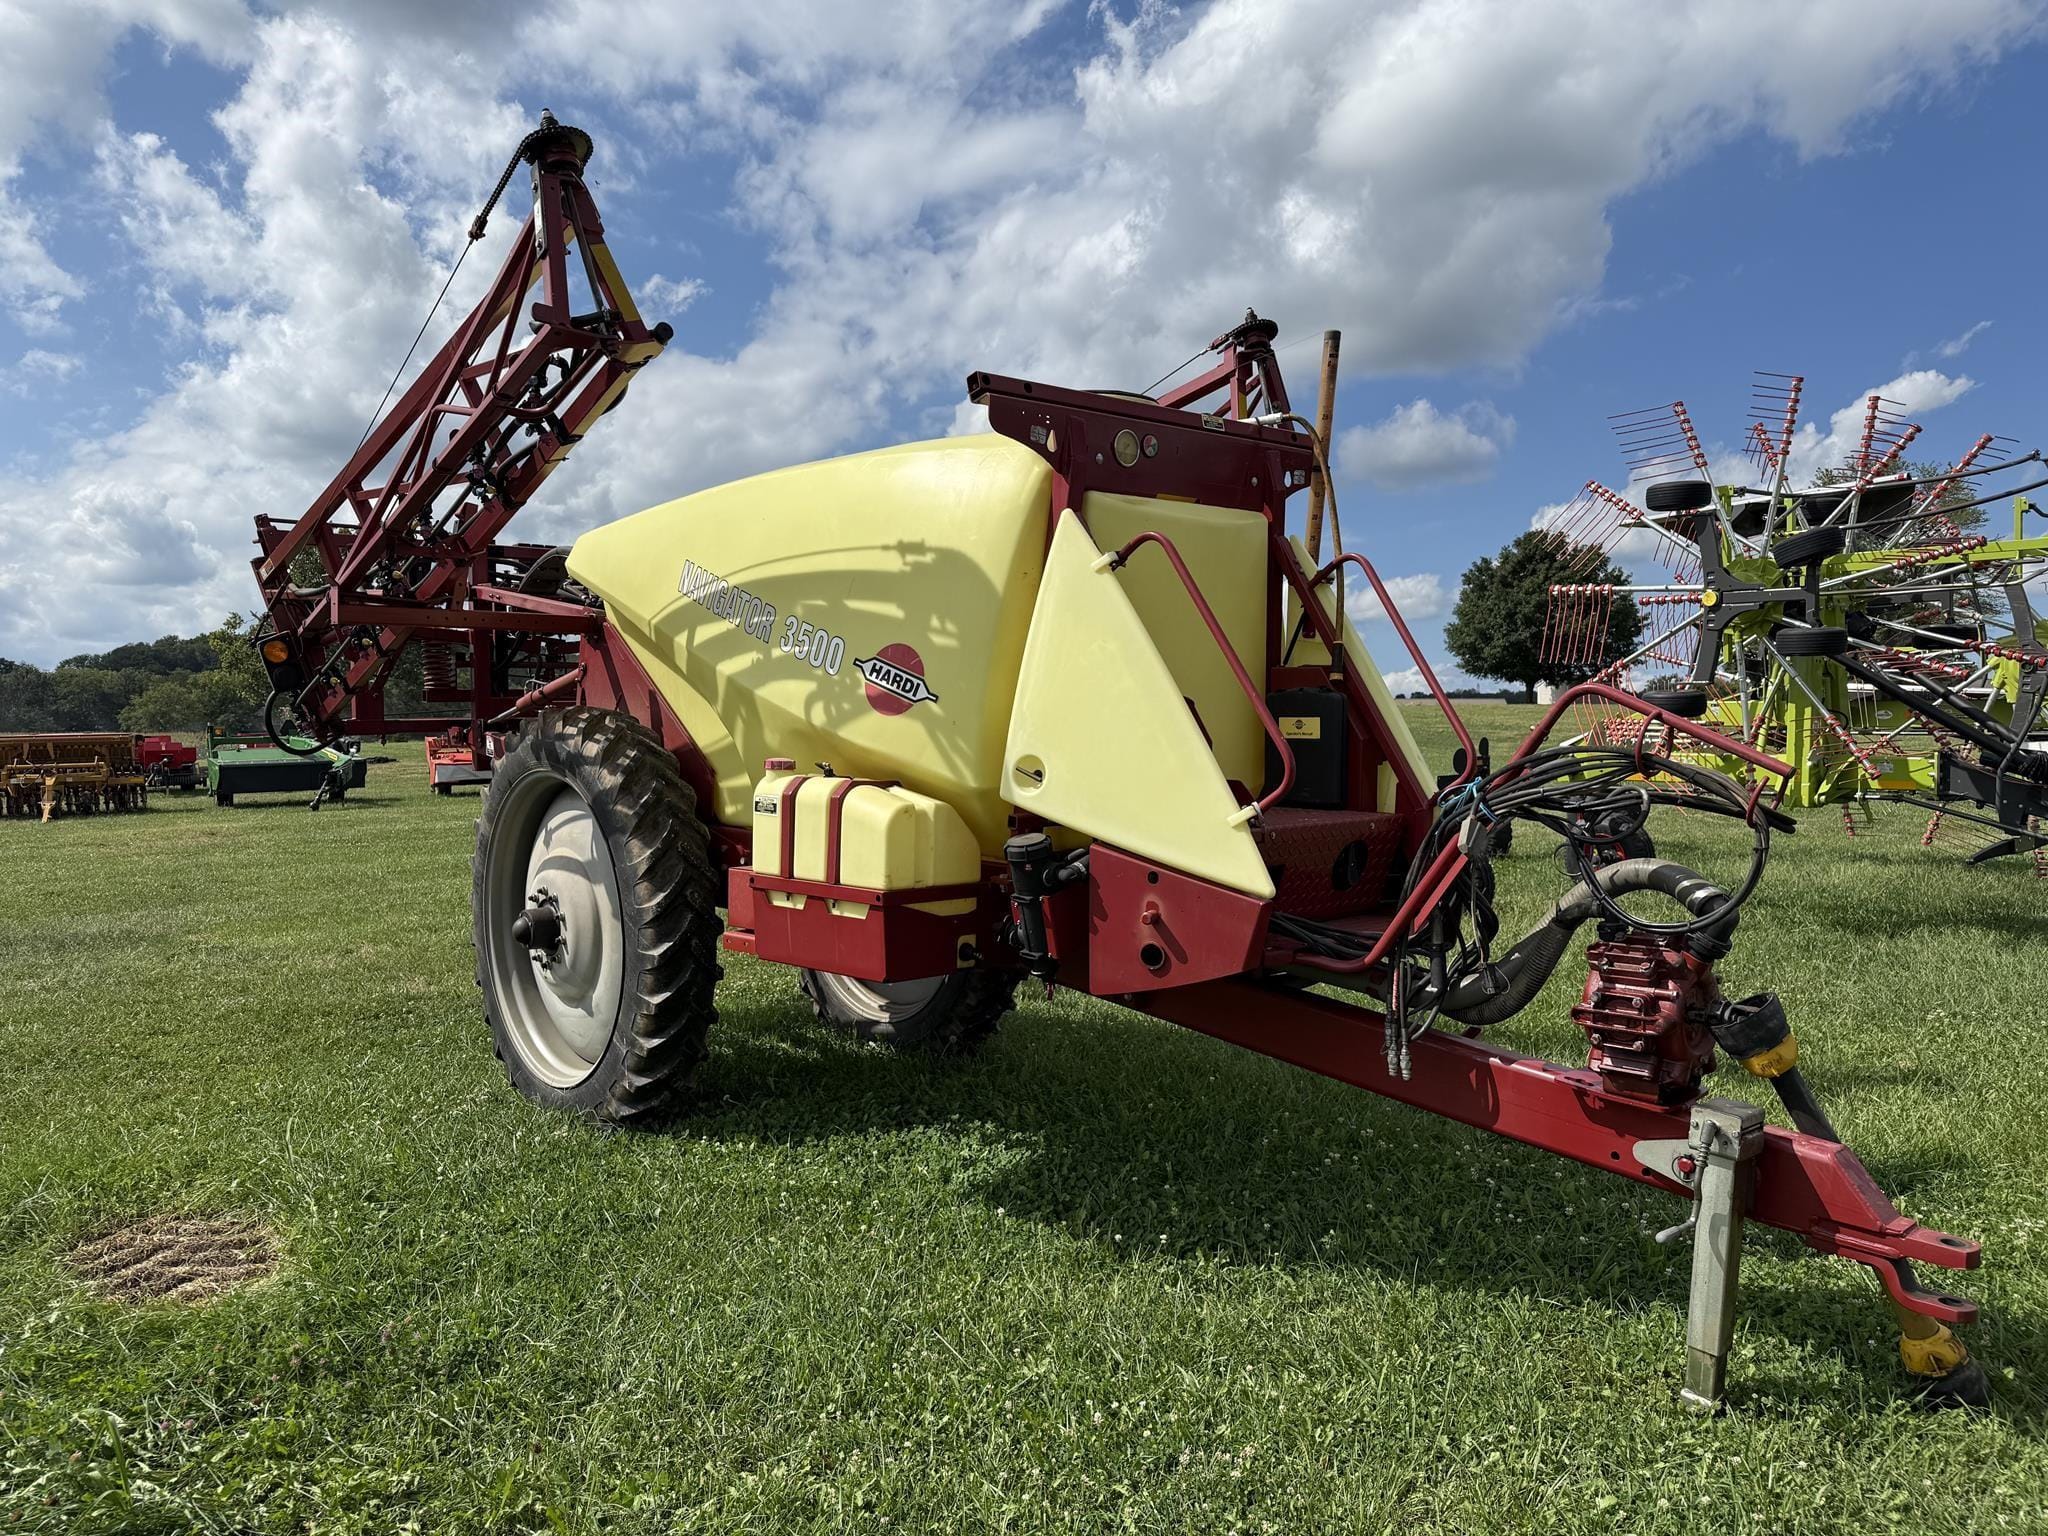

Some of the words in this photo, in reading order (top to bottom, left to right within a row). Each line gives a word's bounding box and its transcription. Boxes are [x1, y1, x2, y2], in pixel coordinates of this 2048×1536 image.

[678, 559, 776, 644] NAVIGATOR
[780, 615, 845, 676] 3500
[869, 662, 922, 698] HARDI
